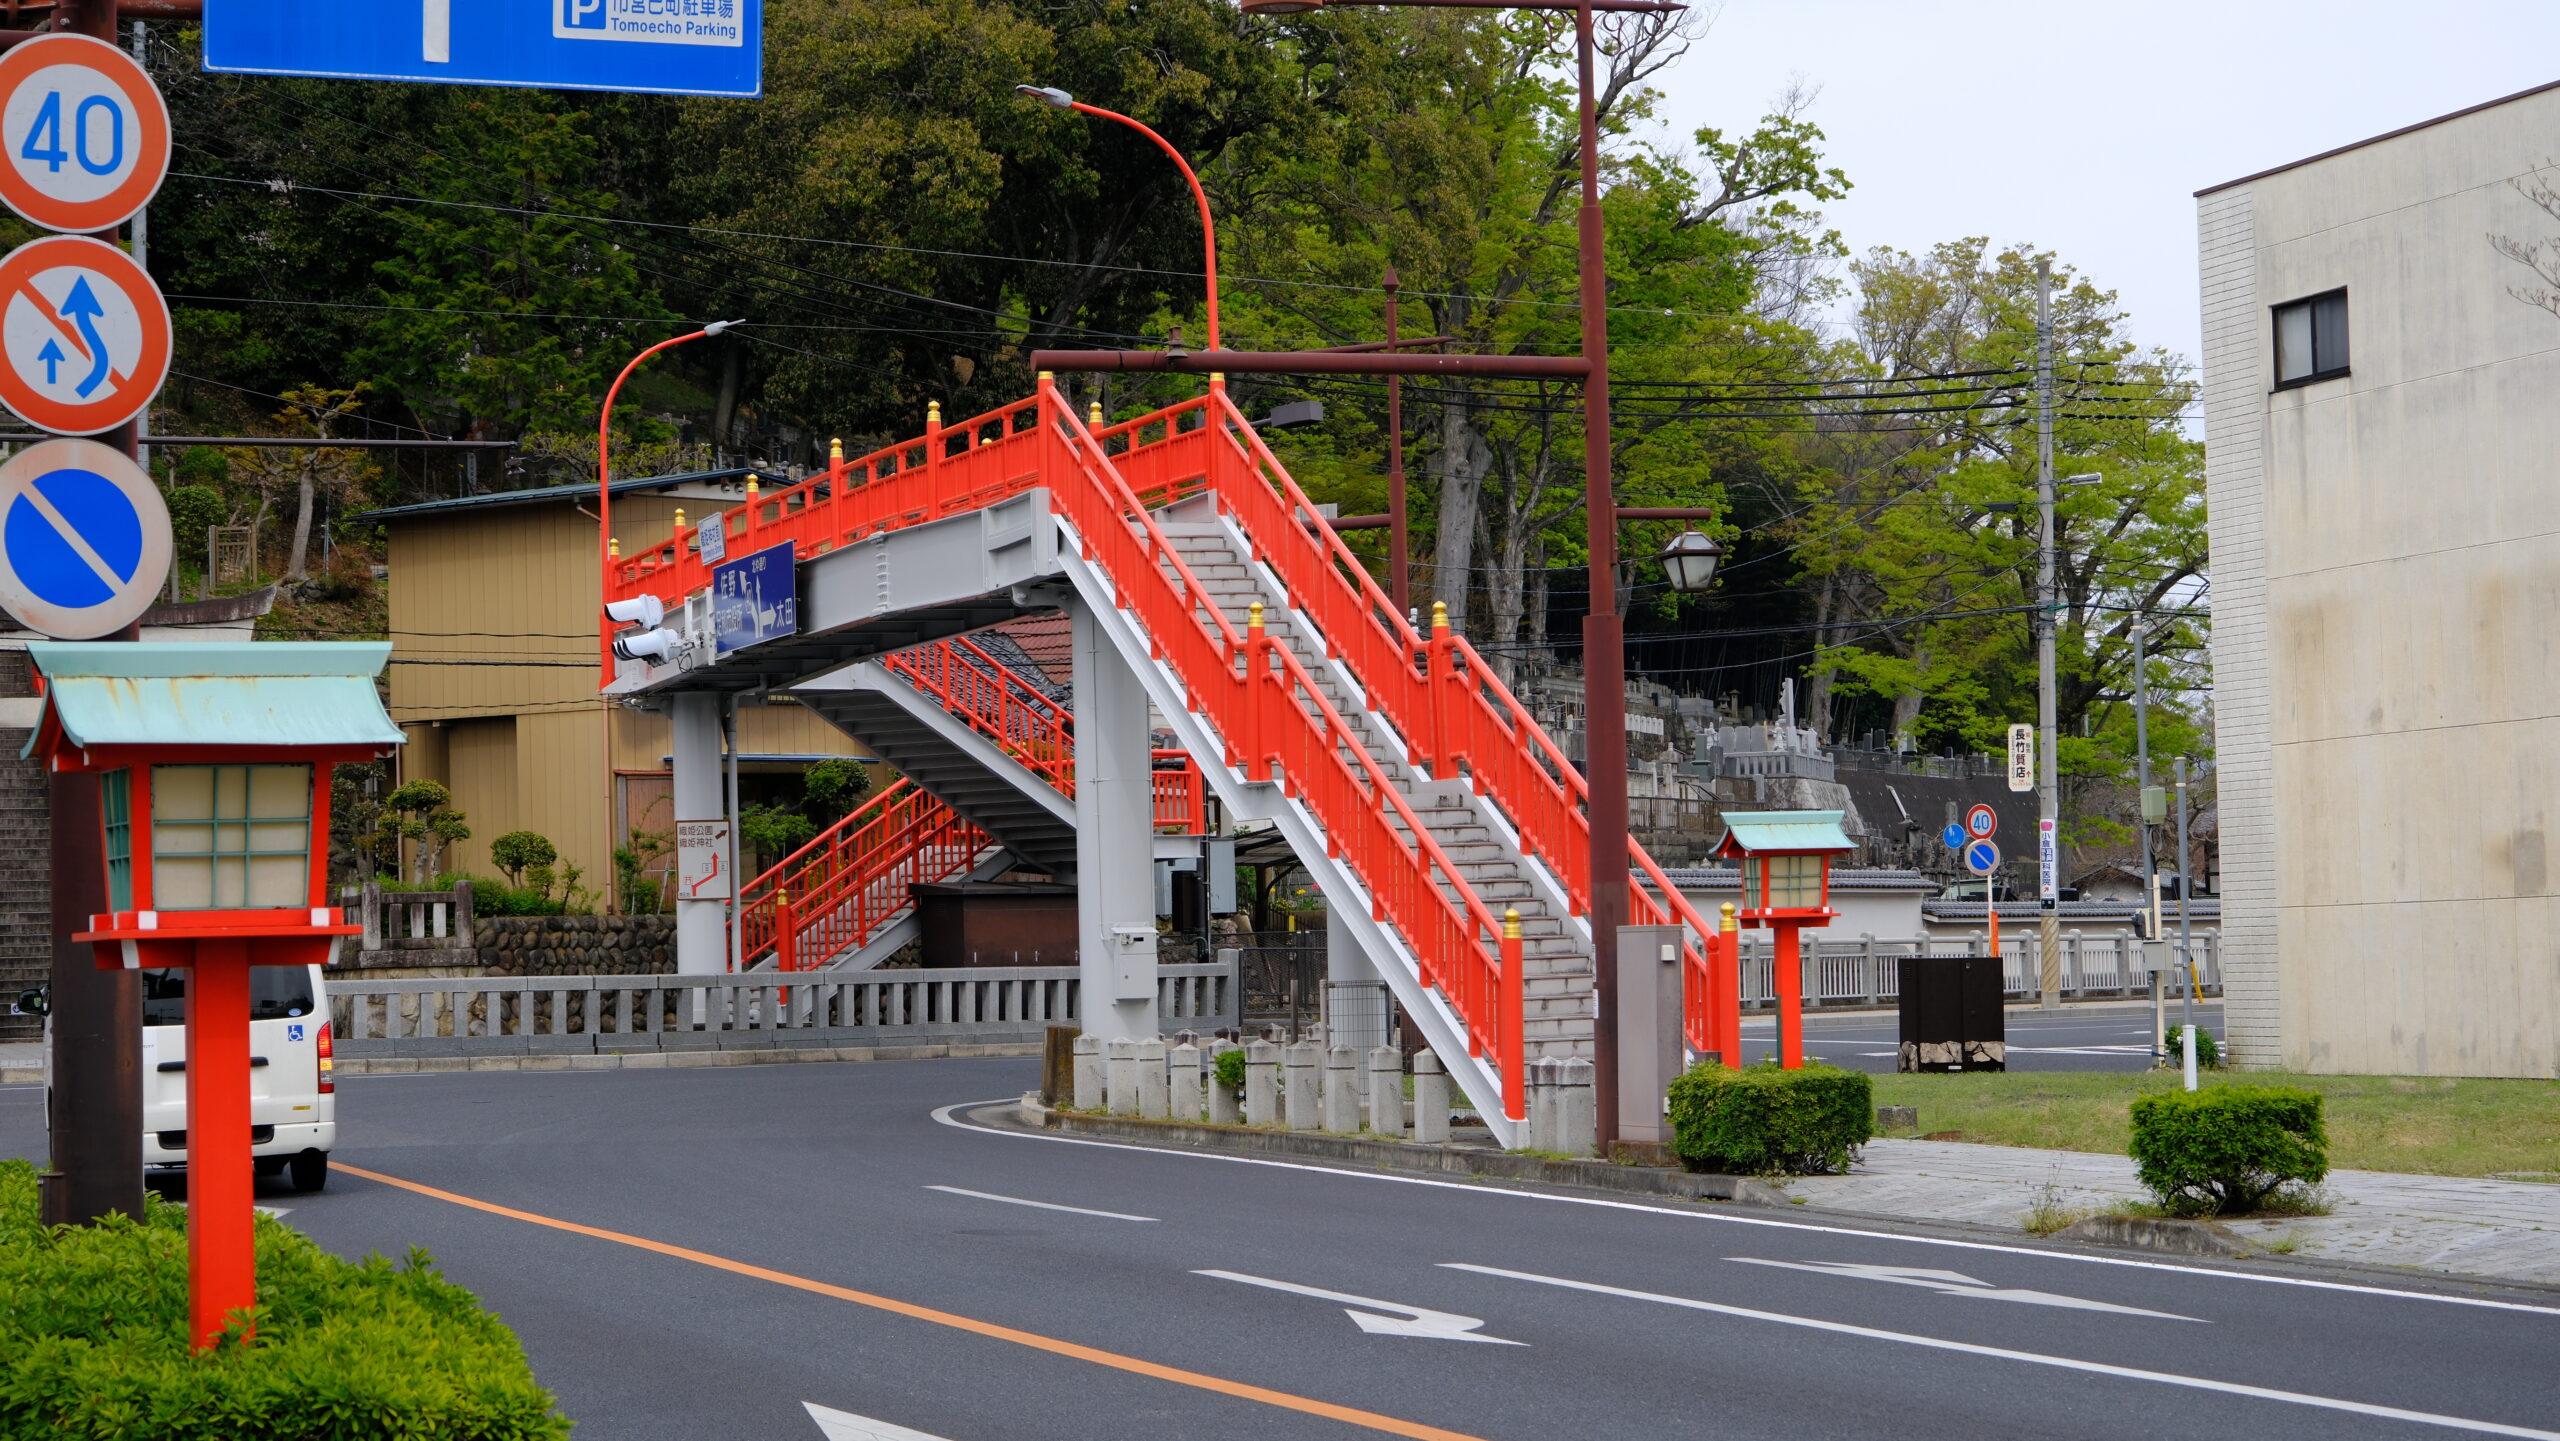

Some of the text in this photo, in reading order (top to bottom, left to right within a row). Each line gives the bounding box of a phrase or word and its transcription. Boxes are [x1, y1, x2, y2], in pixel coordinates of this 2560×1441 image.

[610, 17, 737, 39] Tomoecho Parking
[21, 90, 123, 176] 40
[720, 570, 736, 600] 佐野
[776, 597, 793, 629] 太田
[2016, 728, 2026, 778] 長竹質店
[1973, 814, 1990, 830] 40
